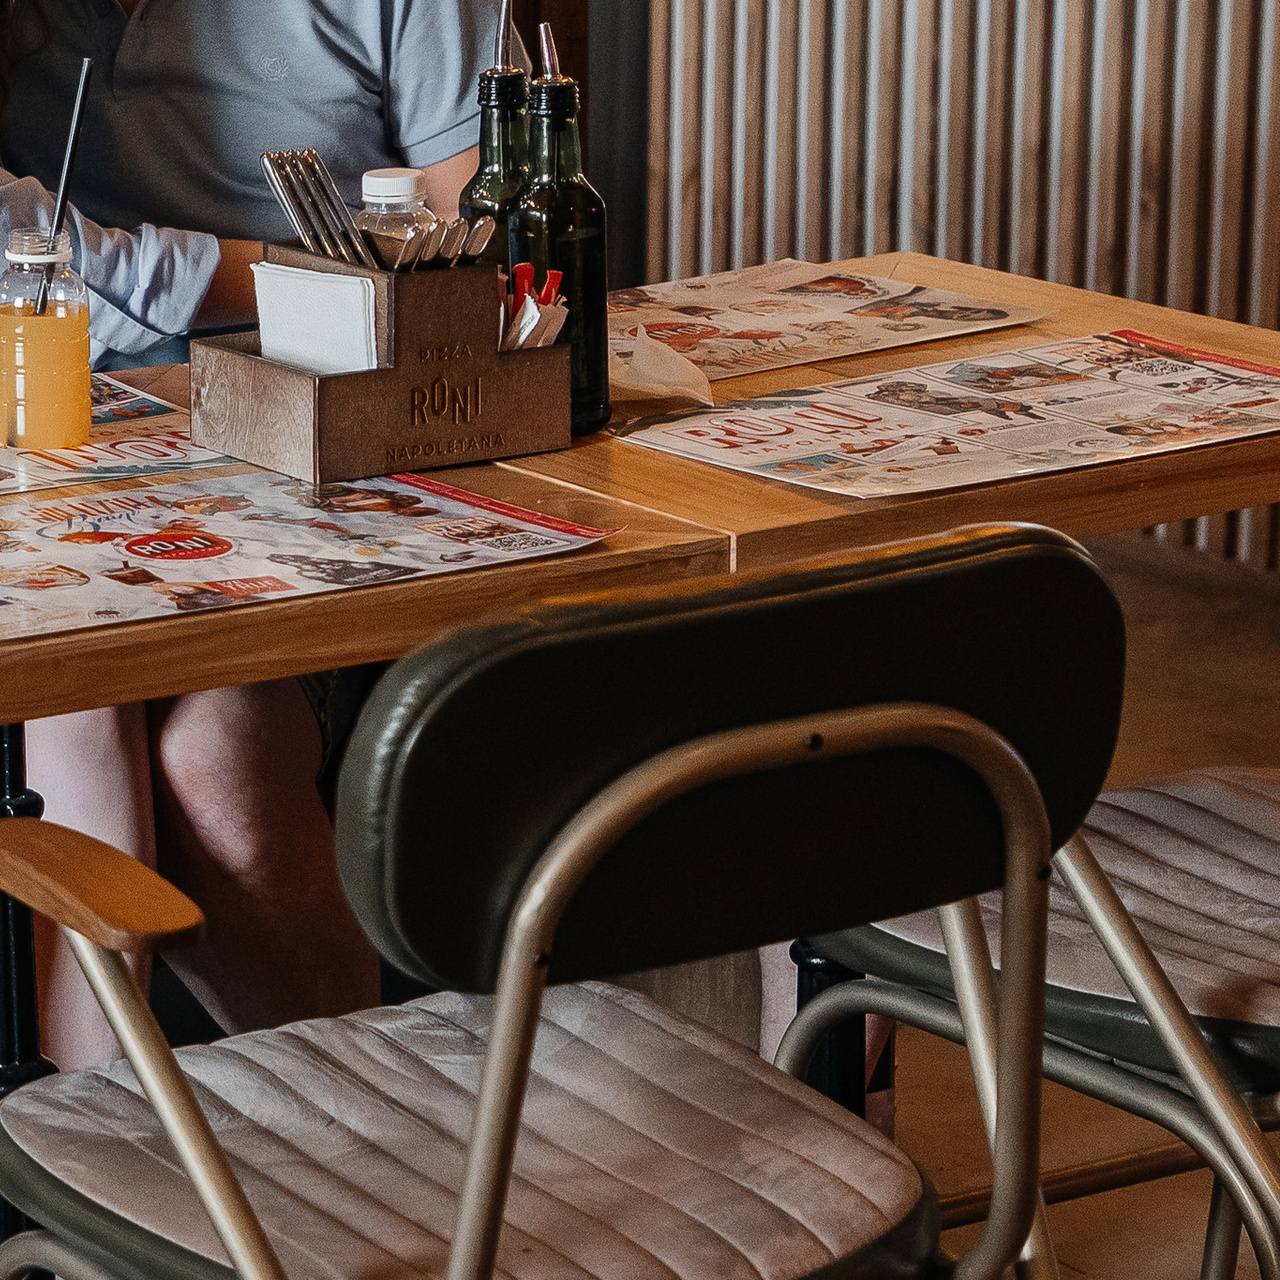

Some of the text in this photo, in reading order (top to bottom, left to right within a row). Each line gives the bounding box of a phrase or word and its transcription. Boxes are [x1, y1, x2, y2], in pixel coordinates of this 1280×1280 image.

[418, 343, 473, 362] PIZZA
[410, 377, 483, 426] RONI
[661, 401, 883, 449] RONI
[386, 433, 505, 461] NAPOLETANA
[130, 535, 214, 556] RONI
